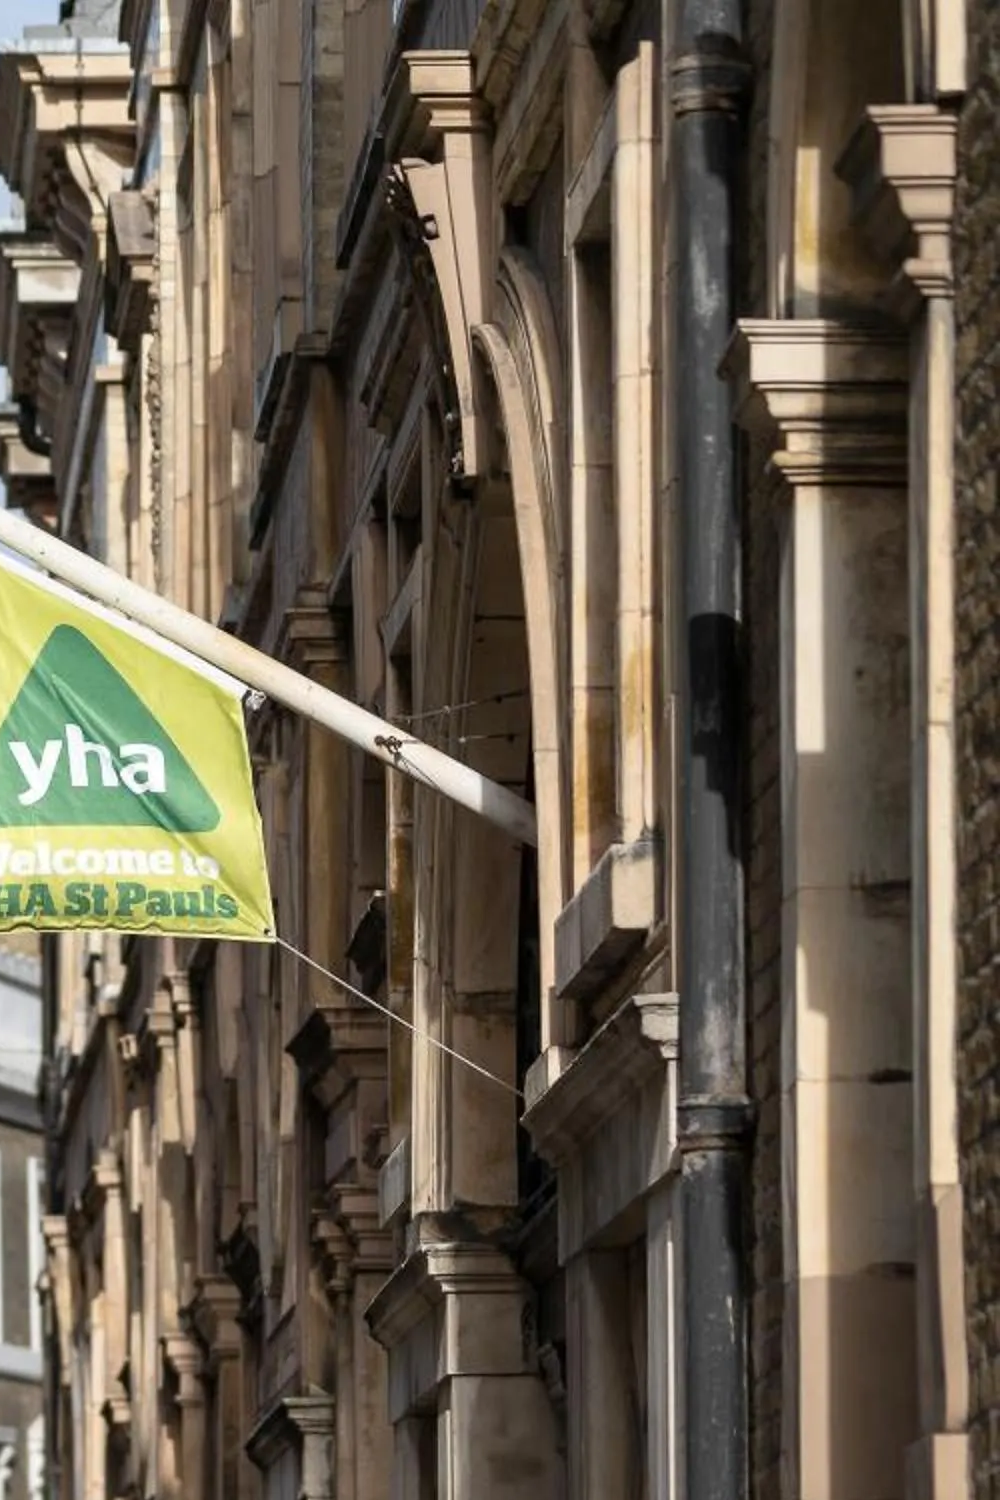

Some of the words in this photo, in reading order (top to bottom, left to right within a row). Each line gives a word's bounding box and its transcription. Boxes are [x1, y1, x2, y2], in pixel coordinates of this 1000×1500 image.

[8, 724, 167, 806] yha
[182, 847, 220, 881] to
[64, 881, 109, 919] St
[115, 883, 239, 920] Pauls
